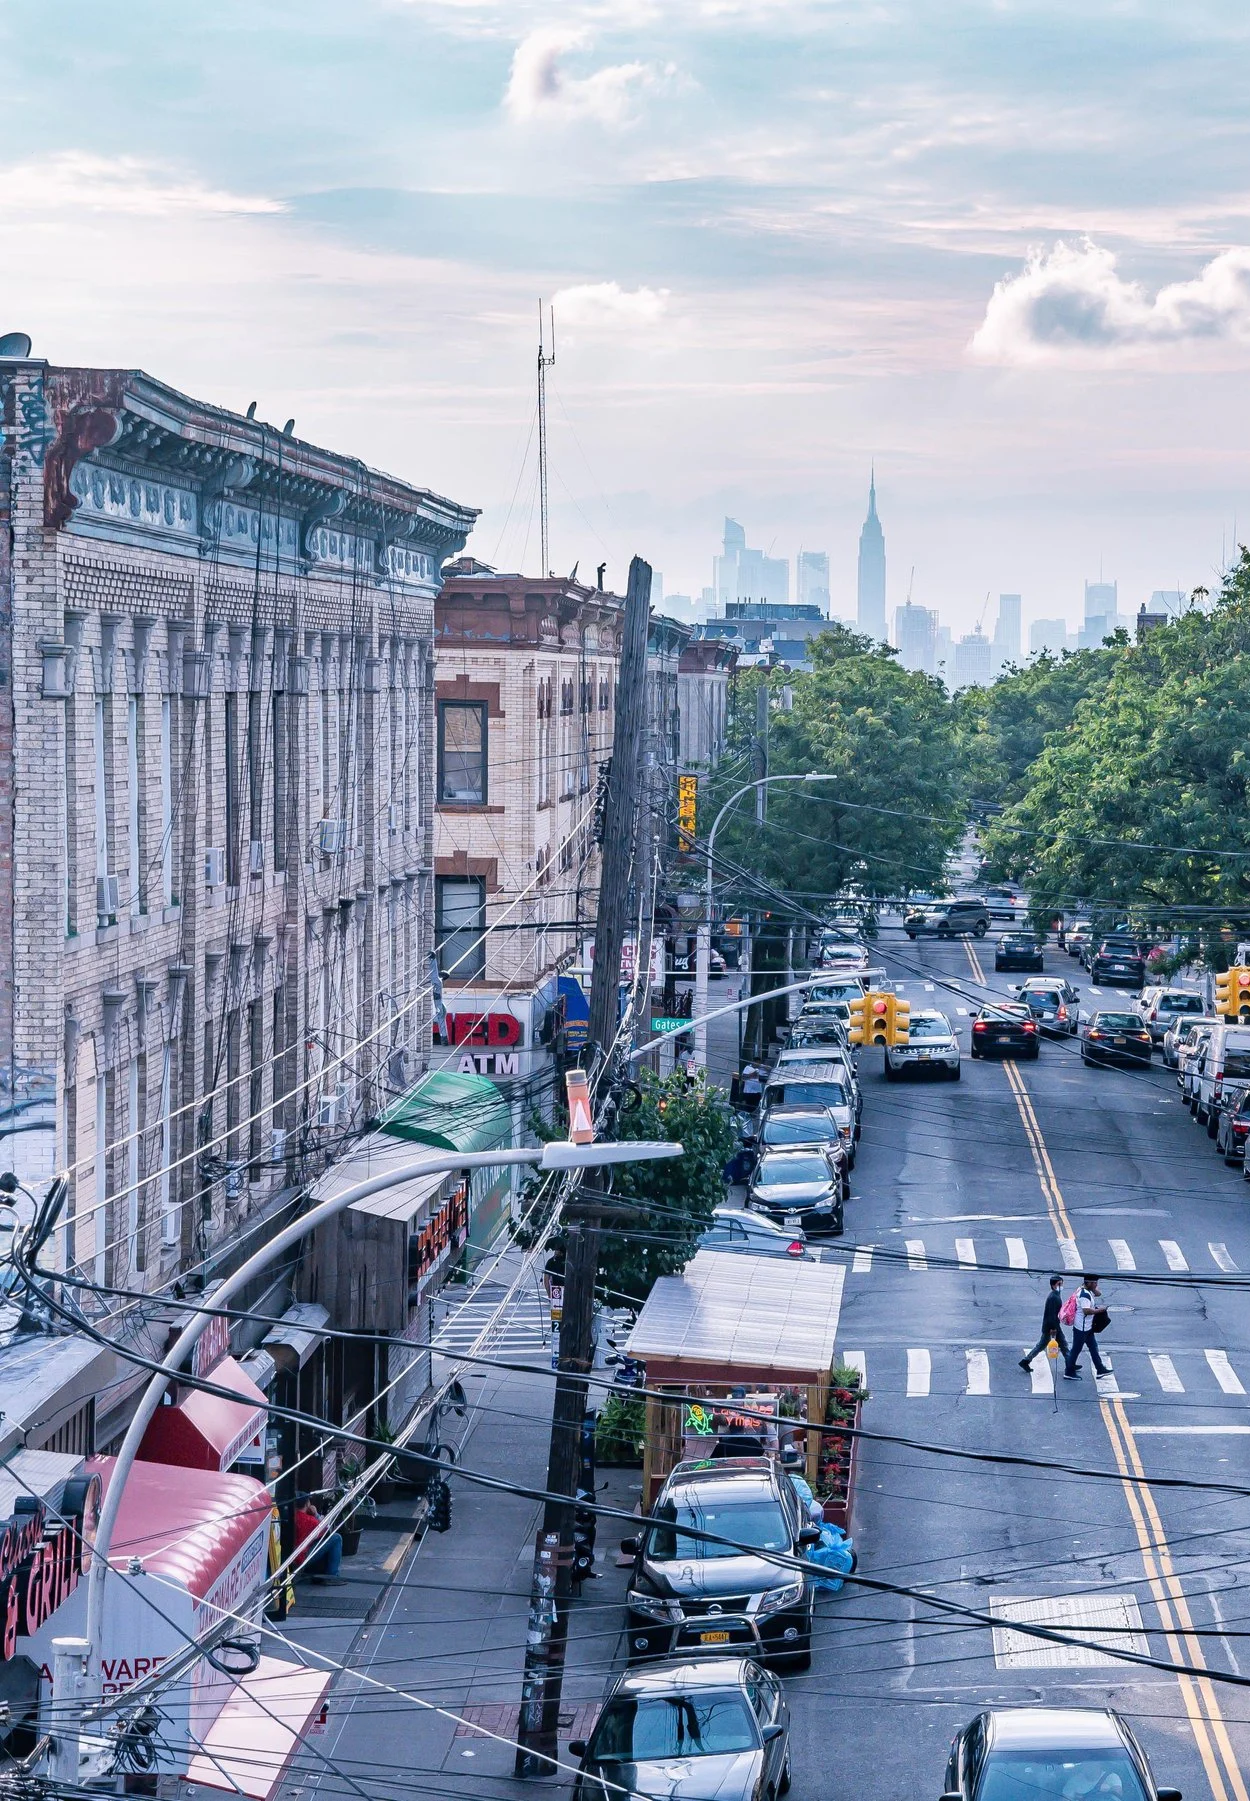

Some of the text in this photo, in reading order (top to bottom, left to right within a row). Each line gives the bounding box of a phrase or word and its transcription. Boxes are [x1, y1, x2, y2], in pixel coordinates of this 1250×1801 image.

[655, 1019, 680, 1030] Gates
[456, 1052, 519, 1075] ATM
[26, 1513, 80, 1637] GRILL
